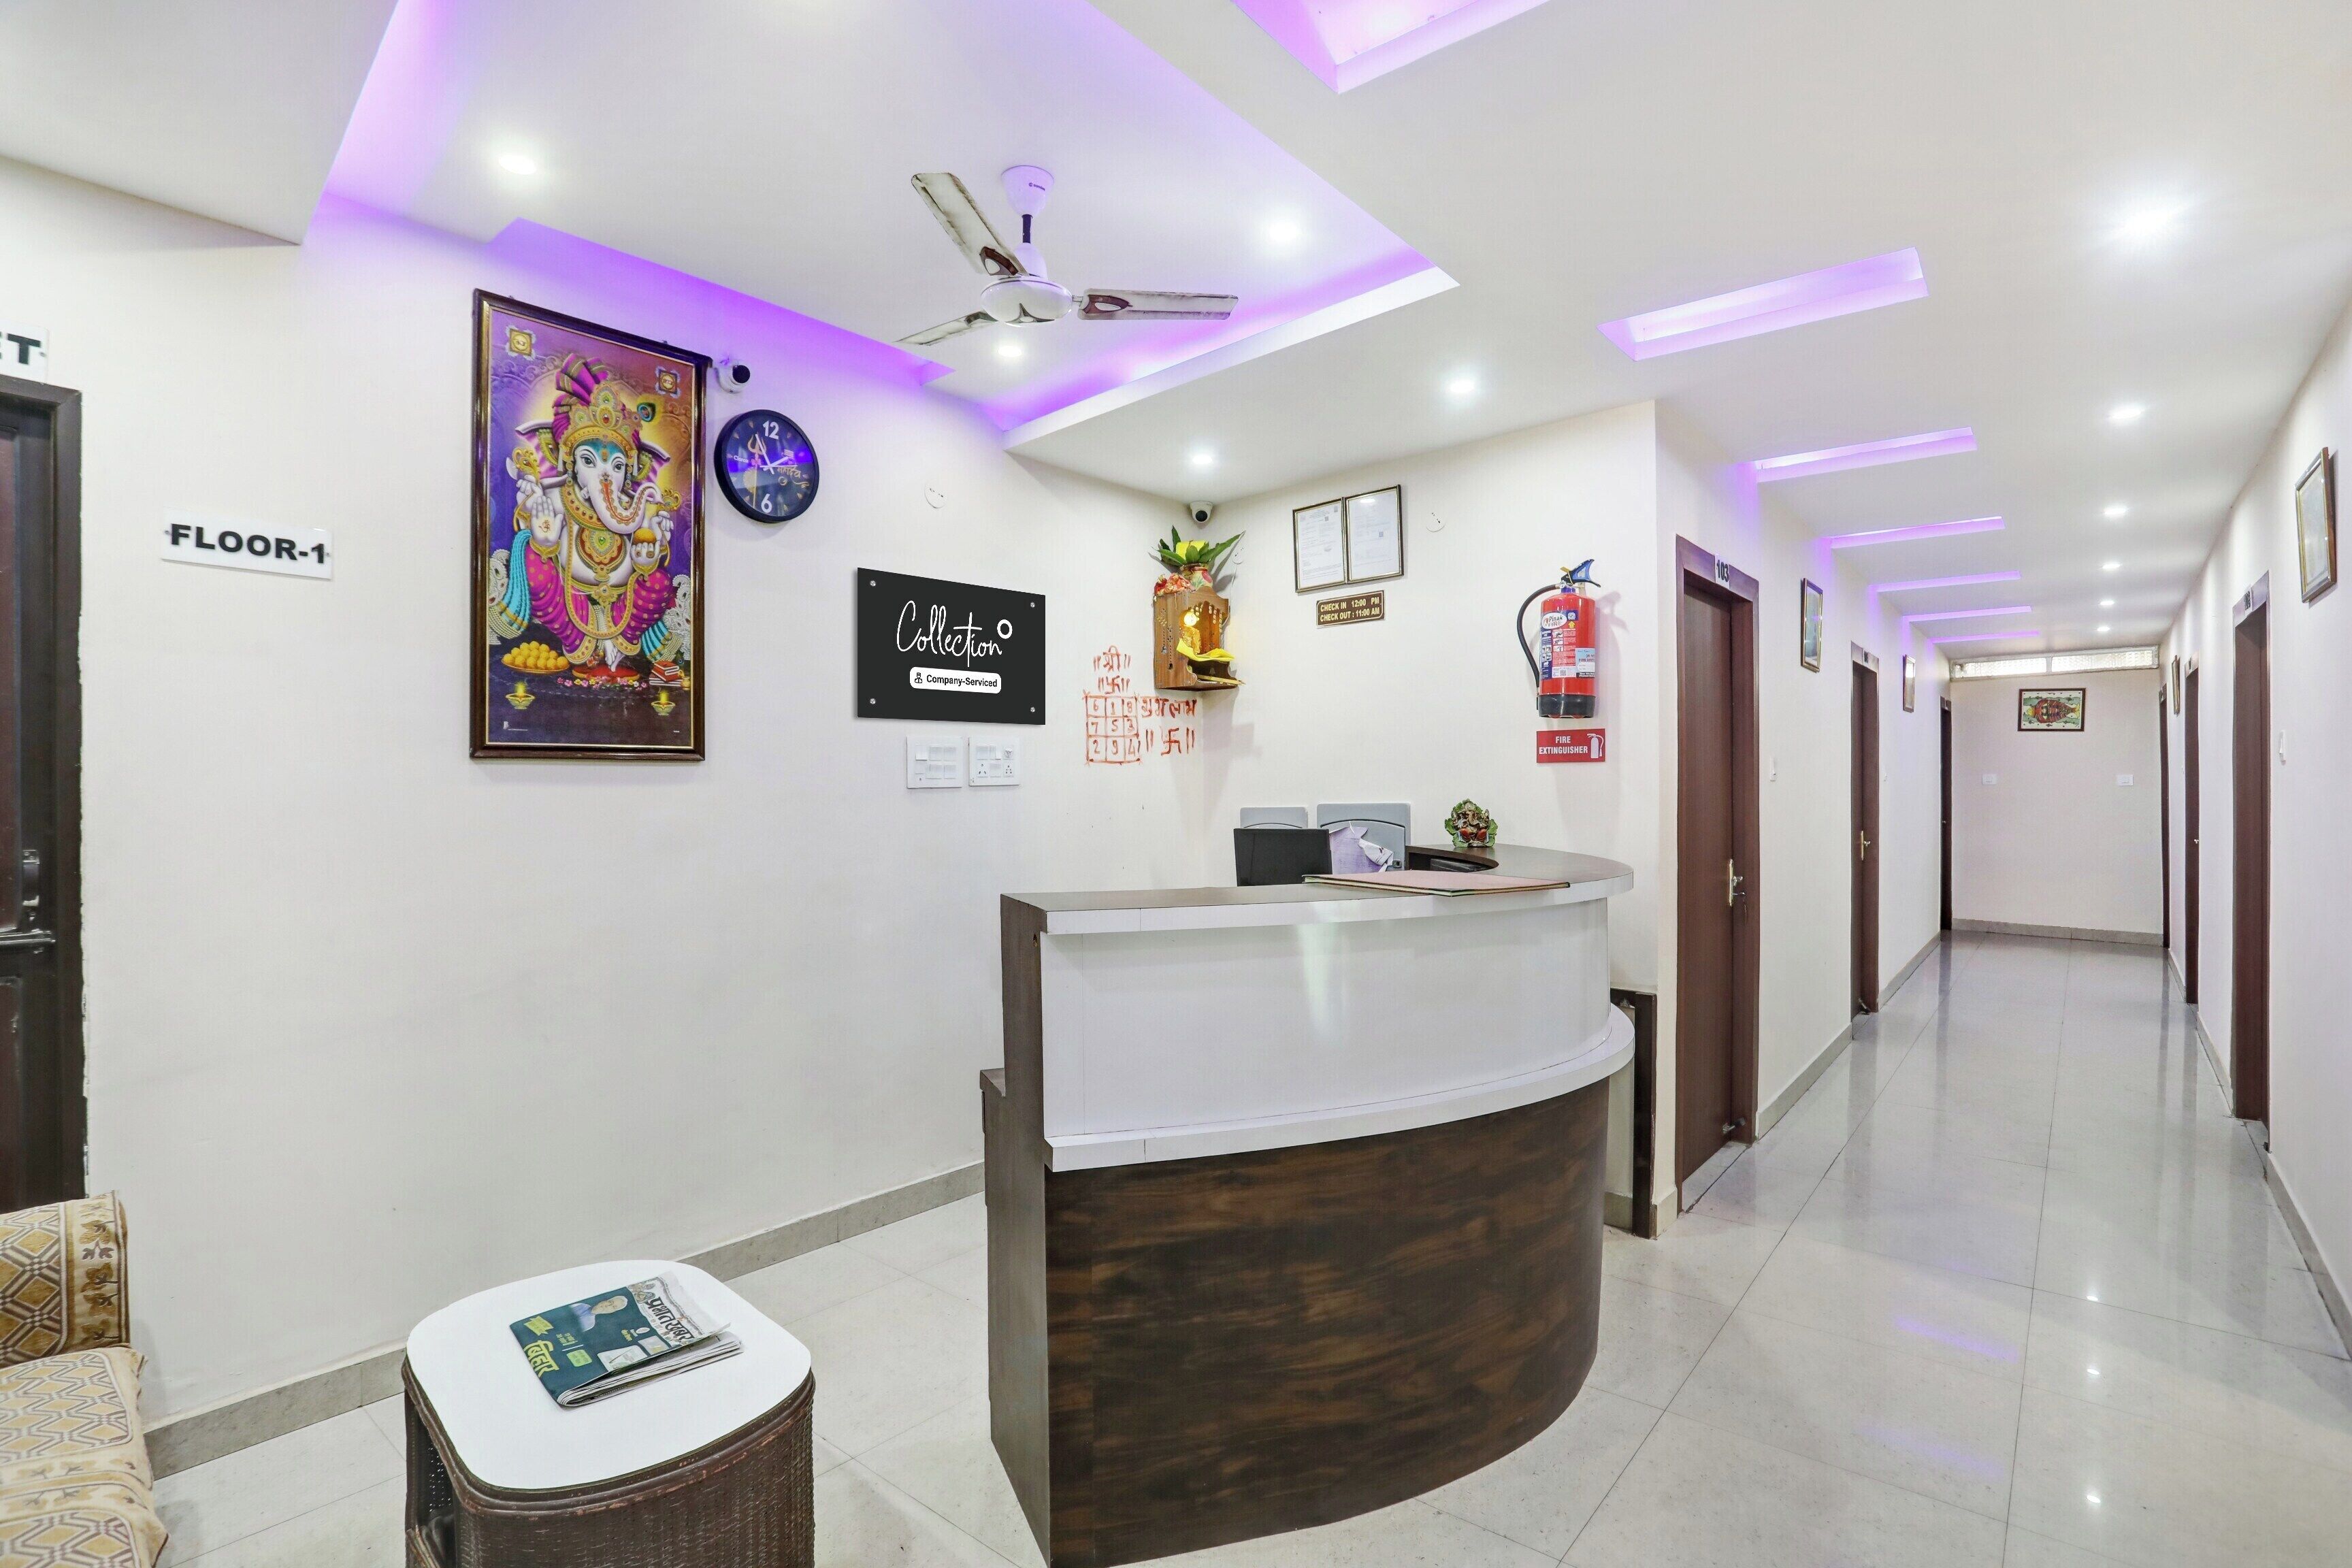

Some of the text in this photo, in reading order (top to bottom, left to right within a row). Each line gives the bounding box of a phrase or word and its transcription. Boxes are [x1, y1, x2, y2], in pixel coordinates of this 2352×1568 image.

[0, 331, 42, 365] T
[762, 420, 779, 440] 12
[761, 493, 772, 513] 6
[171, 523, 325, 564] FLOOR-1
[1716, 559, 1729, 583] 103
[1320, 602, 1339, 612] CHECK
[1351, 598, 1367, 608] 12:00
[1371, 596, 1379, 605] PM
[1320, 612, 1339, 622] CHECK
[1339, 610, 1351, 620] OUT
[1355, 608, 1370, 617] 11:00
[1371, 606, 1380, 615] AM
[897, 600, 1002, 668] Collection
[926, 674, 998, 687] Company-Serviced
[1092, 699, 1099, 711] 6
[1111, 701, 1116, 715] 1
[1091, 721, 1099, 734] 7
[1092, 739, 1100, 755] 2
[1556, 736, 1571, 744] FIRE
[1539, 746, 1588, 754] EXTINGUISHER
